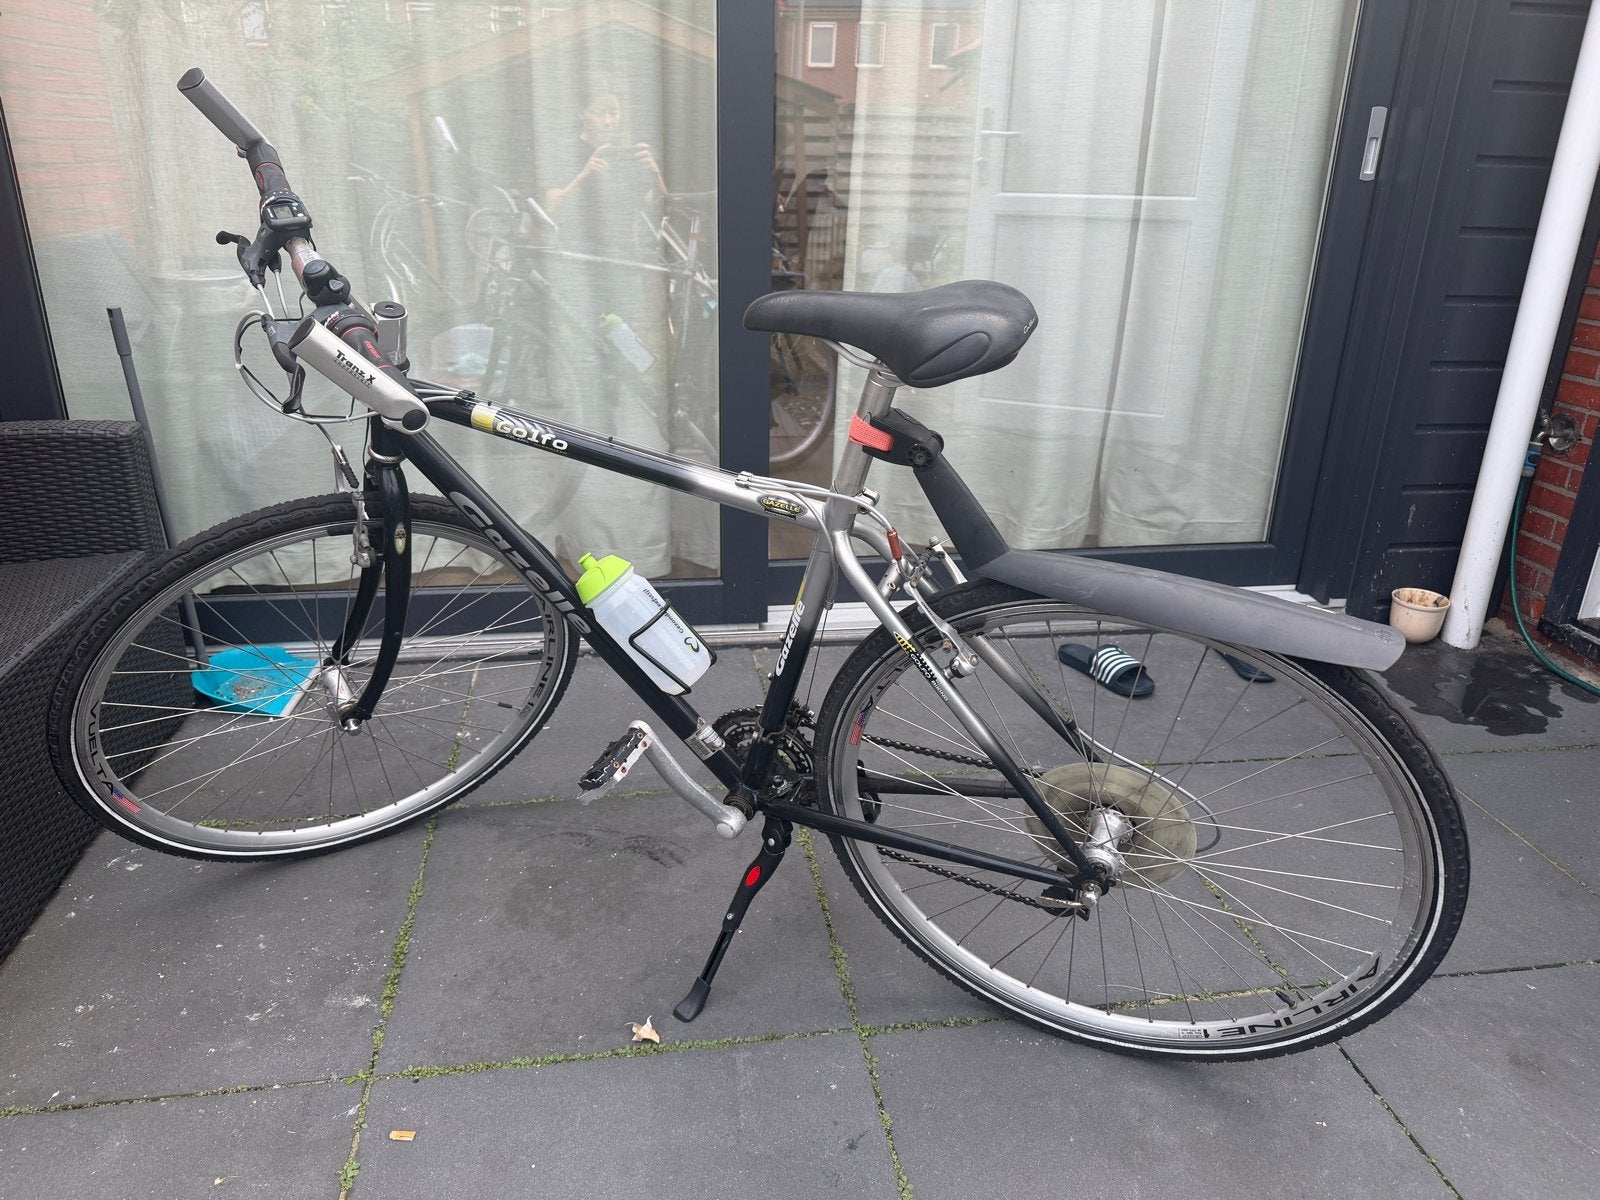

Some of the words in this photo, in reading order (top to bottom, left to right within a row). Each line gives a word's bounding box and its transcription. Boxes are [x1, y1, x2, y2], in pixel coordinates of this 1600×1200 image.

[337, 350, 366, 379] Tranz
[366, 374, 376, 384] X
[496, 420, 568, 451] Golfo
[763, 499, 800, 512] GAZELLE
[449, 491, 591, 634] Gazelle
[776, 600, 805, 677] Gazelle
[87, 699, 115, 795] VUELTA
[1217, 952, 1381, 1038] AIRLINE
